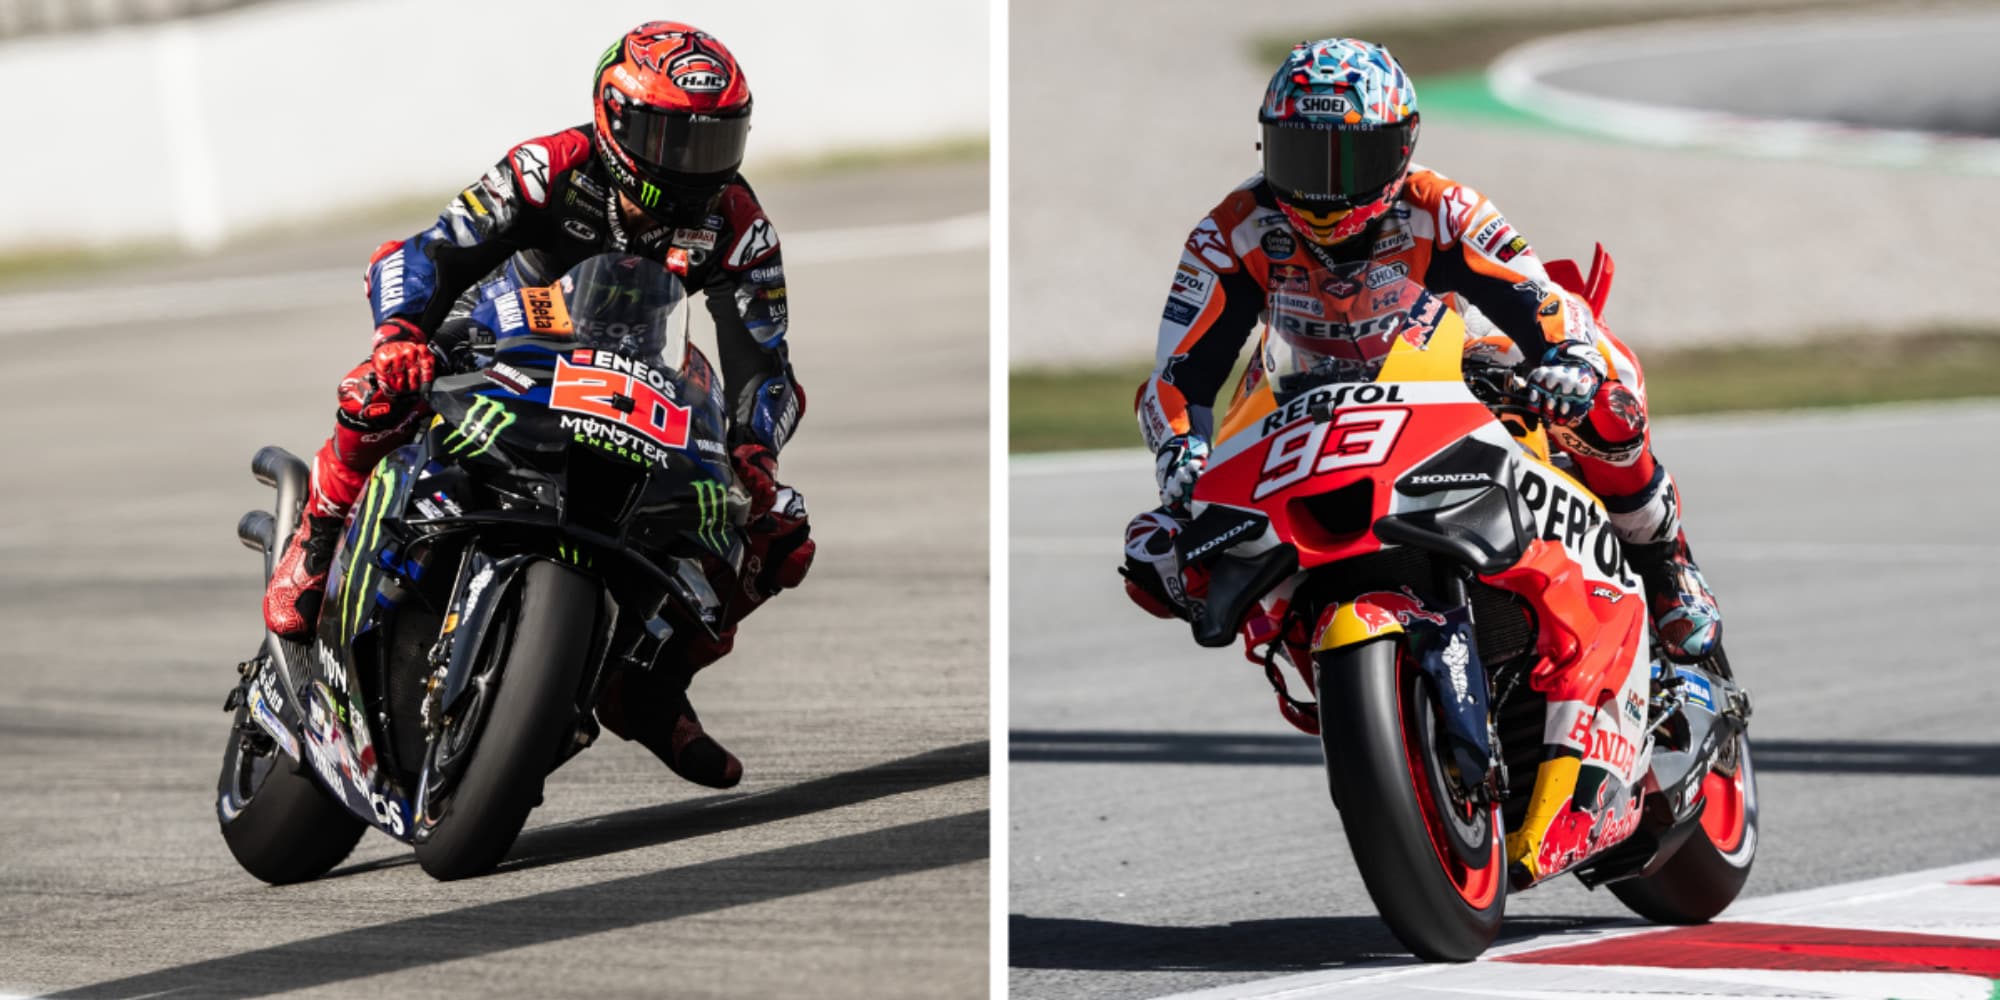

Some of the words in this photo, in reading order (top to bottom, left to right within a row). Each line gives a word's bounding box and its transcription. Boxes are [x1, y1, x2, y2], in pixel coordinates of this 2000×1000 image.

[681, 76, 723, 88] HJC
[1278, 121, 1306, 129] GIVES
[1310, 122, 1333, 131] YOU
[1338, 122, 1375, 132] WINGS
[1301, 98, 1345, 113] SHOEI
[380, 249, 405, 312] YAMAHA
[594, 350, 678, 399] ENEOS
[549, 353, 693, 450] 20
[559, 414, 670, 469] MONSTER
[573, 432, 655, 468] ENERGY
[1252, 407, 1412, 503] 93
[1410, 472, 1493, 486] HONDA
[1185, 519, 1257, 561] HONDA
